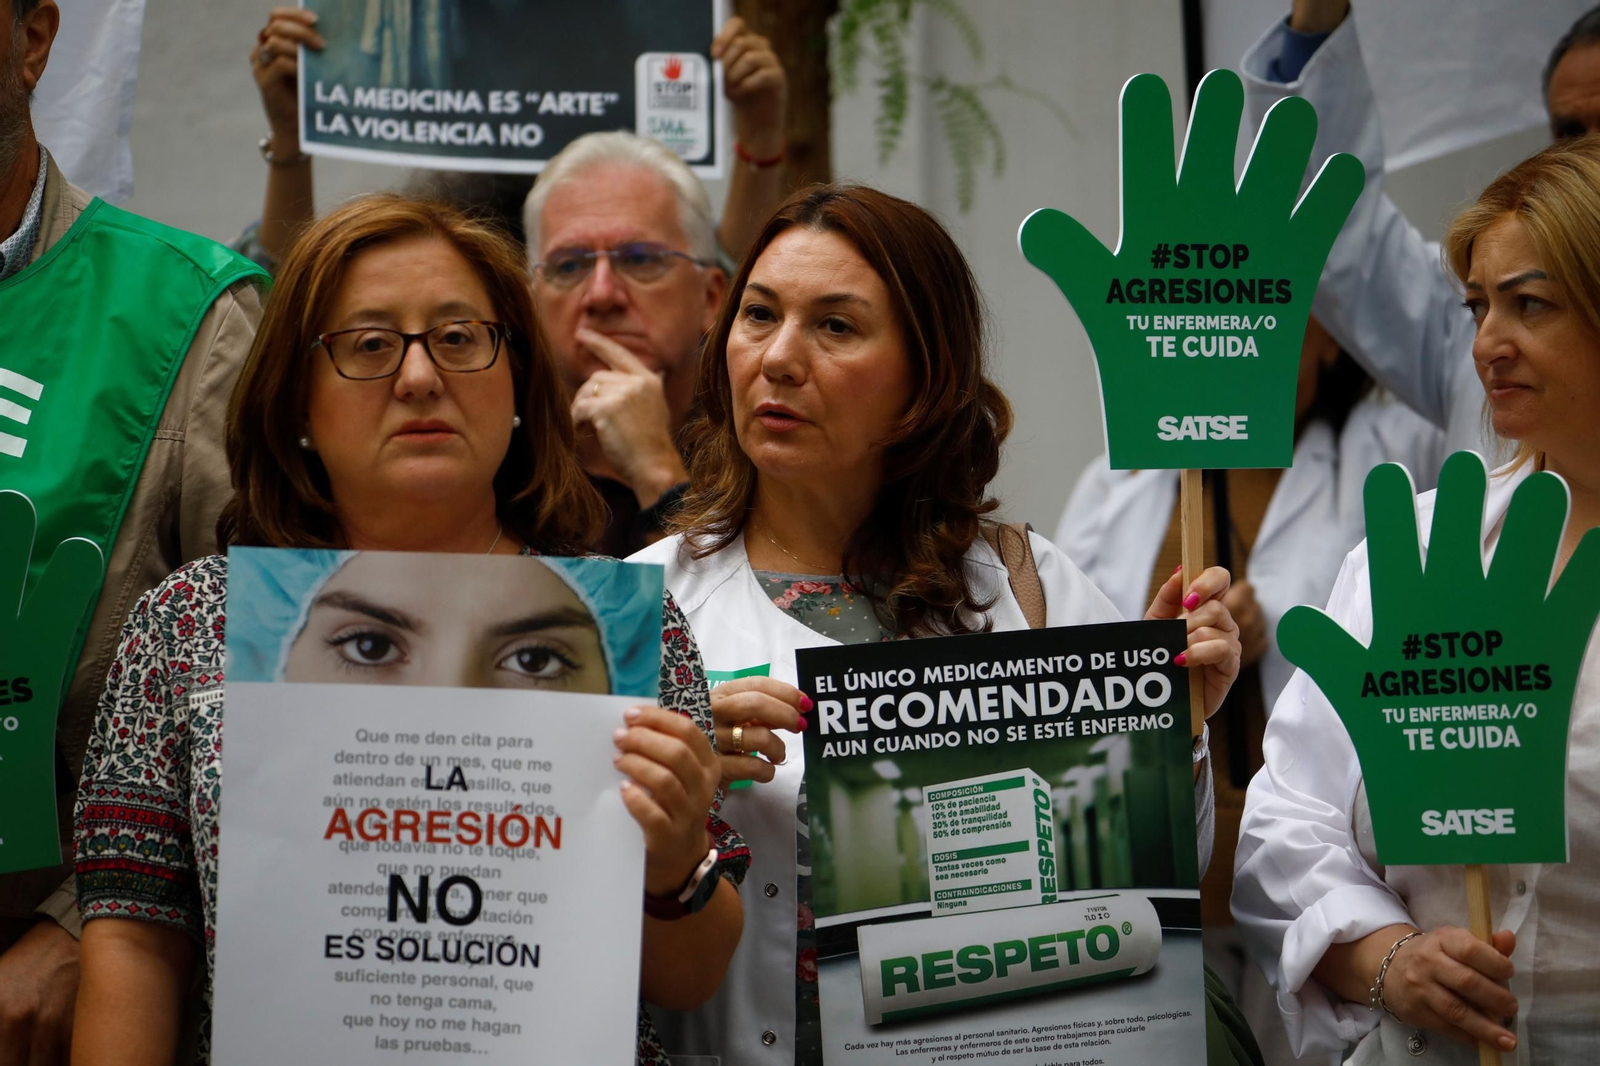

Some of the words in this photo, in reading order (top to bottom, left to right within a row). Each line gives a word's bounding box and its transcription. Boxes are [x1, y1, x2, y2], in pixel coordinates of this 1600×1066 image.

[314, 81, 347, 107] LA
[354, 86, 484, 113] MEDICINA
[488, 91, 521, 114] ES
[315, 110, 349, 135] LA
[351, 115, 498, 146] VIOLENCIA
[501, 123, 543, 147] NO
[1151, 243, 1249, 269] #STOP
[1106, 278, 1292, 304] AGRESIONES
[1126, 315, 1149, 330] TU
[1153, 315, 1277, 330] ENFERMERA/O
[1146, 336, 1176, 358] TE
[1182, 335, 1259, 358] CUIDA
[1157, 415, 1248, 441] SATSE
[1402, 630, 1503, 660] #STOP
[815, 675, 837, 693] EL
[843, 668, 916, 692] ÚNICO
[923, 654, 1083, 685] MEDICAMENTO
[1090, 652, 1116, 670] DE
[1123, 647, 1170, 668] USO
[1361, 664, 1552, 698] AGRESIONES
[817, 672, 1172, 735] RECOMENDADO
[1382, 708, 1405, 723] TU
[1409, 703, 1537, 723] ENFERMERA/O
[355, 729, 389, 745] Que
[395, 732, 420, 745] me
[425, 731, 456, 745] den
[461, 732, 491, 747] cita
[497, 735, 533, 750] para
[822, 739, 867, 758] AUN
[873, 731, 961, 753] CUANDO
[968, 728, 999, 746] NO
[1007, 725, 1027, 742] SE
[1034, 716, 1074, 739] ESTÉ
[1081, 713, 1174, 735] ENFERMO
[1403, 728, 1434, 751] TE
[1440, 725, 1521, 749] CUIDA
[334, 750, 389, 765] dentro
[394, 751, 414, 766] de
[420, 755, 440, 766] un
[491, 758, 522, 772] que
[528, 759, 552, 772] me
[333, 772, 405, 788] atiendan
[521, 781, 552, 796] que
[425, 765, 468, 792] LA
[323, 793, 354, 808] aún
[359, 796, 381, 808] no
[385, 794, 431, 810] estén
[437, 796, 463, 811] los
[930, 785, 984, 801] COMPOSICIÓN
[931, 802, 946, 812] 10%
[947, 801, 957, 809] de
[959, 794, 996, 808] paciencia
[932, 811, 946, 820] 10%
[948, 810, 957, 818] de
[959, 803, 1001, 816] amabilidad
[932, 820, 948, 830] 30%
[950, 819, 960, 827] de
[961, 811, 1008, 826] tranquilidad
[1421, 808, 1516, 836] SATSE
[323, 804, 562, 850] AGRESIÓN
[933, 829, 949, 839] 50%
[950, 828, 960, 836] de
[962, 820, 1012, 836] comprensión
[443, 843, 463, 856] no
[468, 844, 485, 857] te
[934, 852, 958, 861] DOSIS
[377, 863, 408, 878] que
[414, 864, 434, 876] no
[440, 863, 501, 880] puedan
[934, 863, 960, 873] Tantas
[985, 857, 1006, 865] como
[935, 873, 949, 881] sea
[950, 868, 989, 879] necesario
[387, 874, 483, 926] NO
[517, 891, 548, 904] que
[936, 882, 1022, 899] CONTRAINDICACIONES
[937, 899, 968, 910] Ninguna
[352, 928, 383, 940] con
[389, 927, 432, 941] otros
[325, 935, 365, 960] ES
[375, 936, 540, 968] SOLUCIÓN
[334, 969, 416, 985] suficiente
[422, 973, 498, 990] personal,
[504, 979, 534, 992] que
[370, 993, 391, 1006] no
[397, 994, 443, 1010] tenga
[448, 998, 497, 1012] cama,
[343, 1014, 374, 1029] que
[379, 1014, 410, 1031] hoy
[415, 1018, 436, 1030] no
[442, 1019, 466, 1032] me
[472, 1016, 521, 1037] hagan
[844, 1042, 865, 1051] Cada
[880, 1040, 894, 1049] hay
[895, 1038, 912, 1046] más
[913, 1034, 953, 1045] agresiones
[963, 1030, 995, 1041] personal
[996, 1027, 1030, 1037] sanitario.
[1032, 1024, 1072, 1034] Agresiones
[1104, 1017, 1125, 1026] sobre
[1147, 1010, 1192, 1022] psicológicas.
[375, 1036, 398, 1050] las
[910, 1045, 952, 1055] enfermeras
[960, 1040, 1001, 1049] enfermeros
[1032, 1035, 1055, 1043] centro
[1057, 1031, 1097, 1040] trabajamos
[1098, 1029, 1115, 1037] para
[1117, 1025, 1145, 1034] cuidarle
[946, 1052, 974, 1061] respeto
[976, 1050, 999, 1058] mútuo
[1034, 1044, 1051, 1052] base
[1064, 1041, 1079, 1049] esta
[1081, 1039, 1112, 1047] relación.
